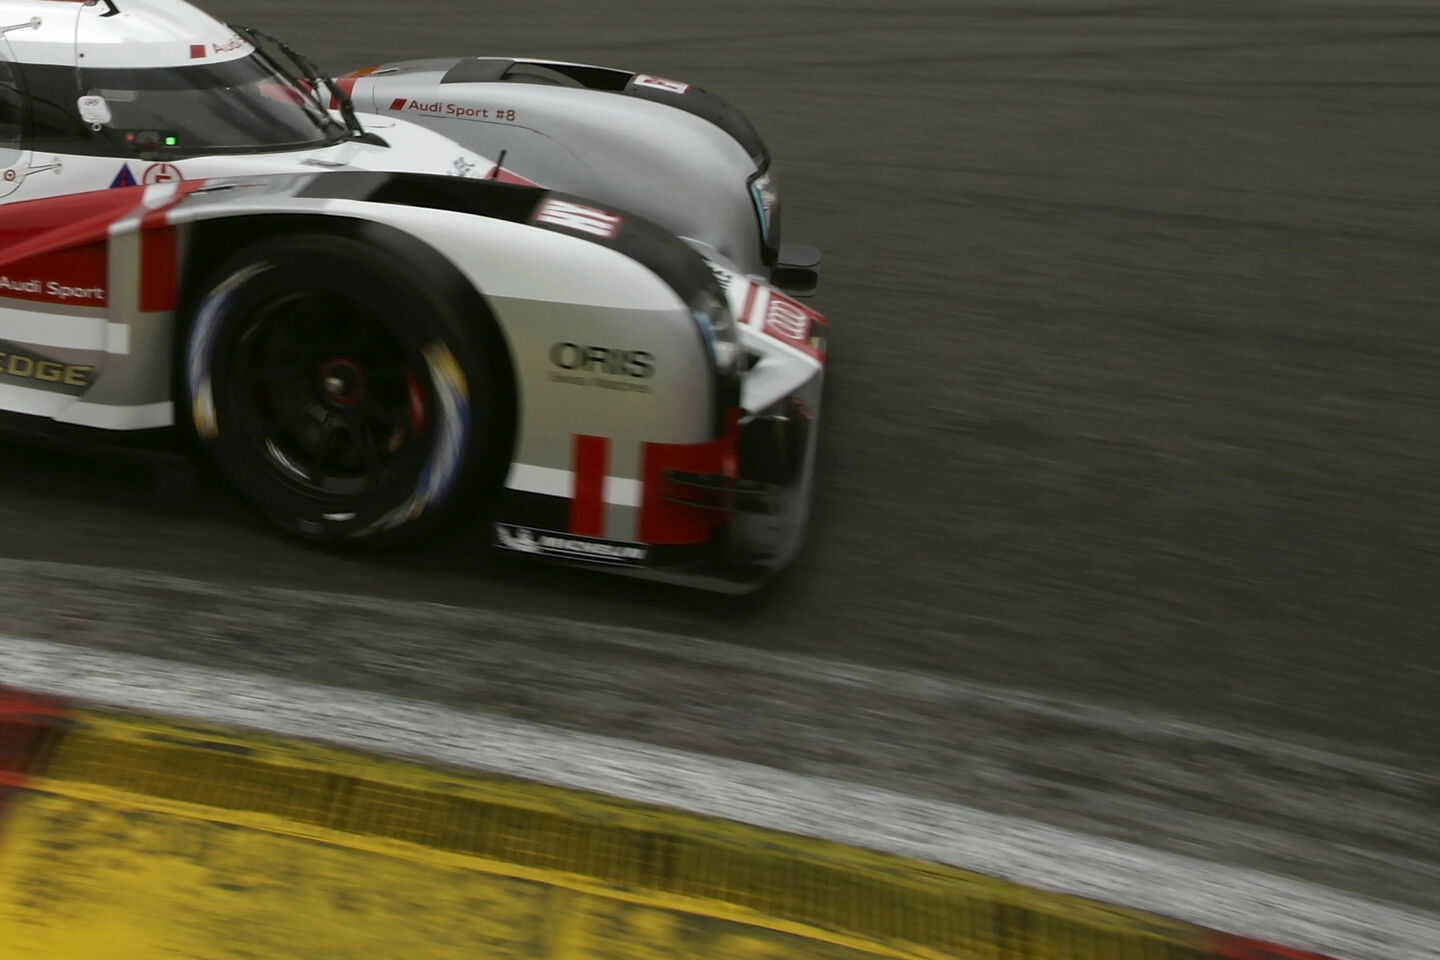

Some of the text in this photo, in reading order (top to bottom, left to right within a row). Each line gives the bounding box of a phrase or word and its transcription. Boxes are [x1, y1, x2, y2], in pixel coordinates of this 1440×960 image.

[409, 100, 516, 121] Audi Sport #8
[46, 281, 105, 300] Sport
[549, 341, 656, 379] ORIS
